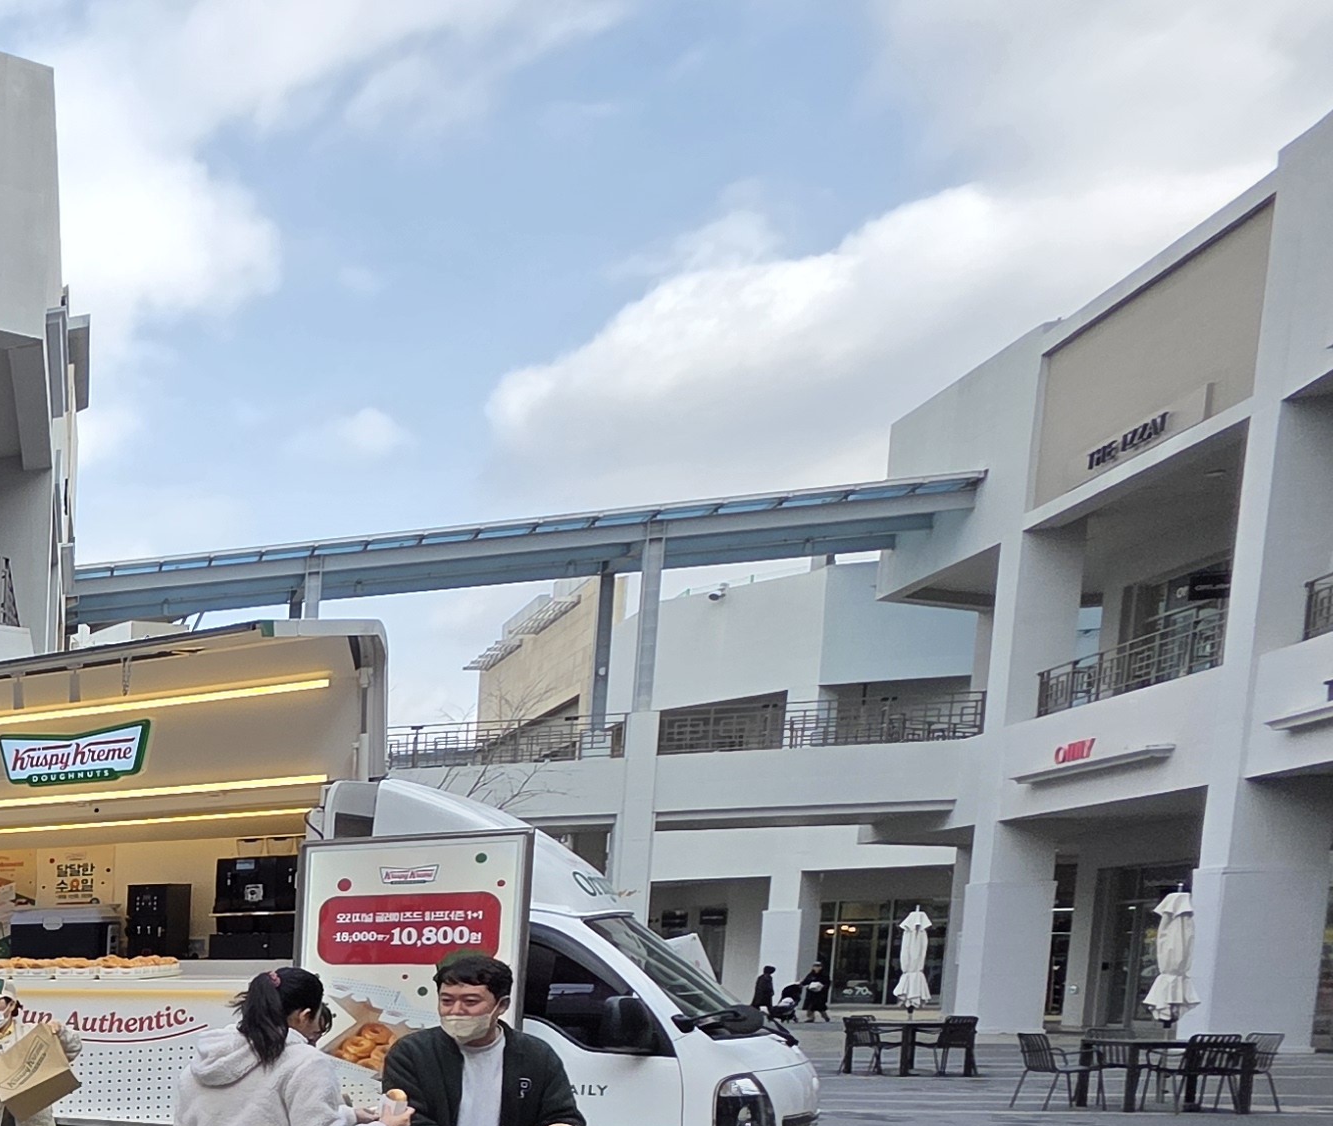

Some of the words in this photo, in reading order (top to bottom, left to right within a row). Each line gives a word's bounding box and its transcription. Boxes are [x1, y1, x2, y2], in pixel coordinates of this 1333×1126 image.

[12, 744, 73, 771] Krispy
[72, 737, 136, 766] Kreme
[32, 769, 110, 783] DOUGHNUTS
[56, 862, 95, 878] 달달한
[55, 878, 94, 893] 수요일
[466, 910, 483, 921] 1+1
[65, 1006, 195, 1034] Authentic.
[570, 1084, 609, 1097] AILY
